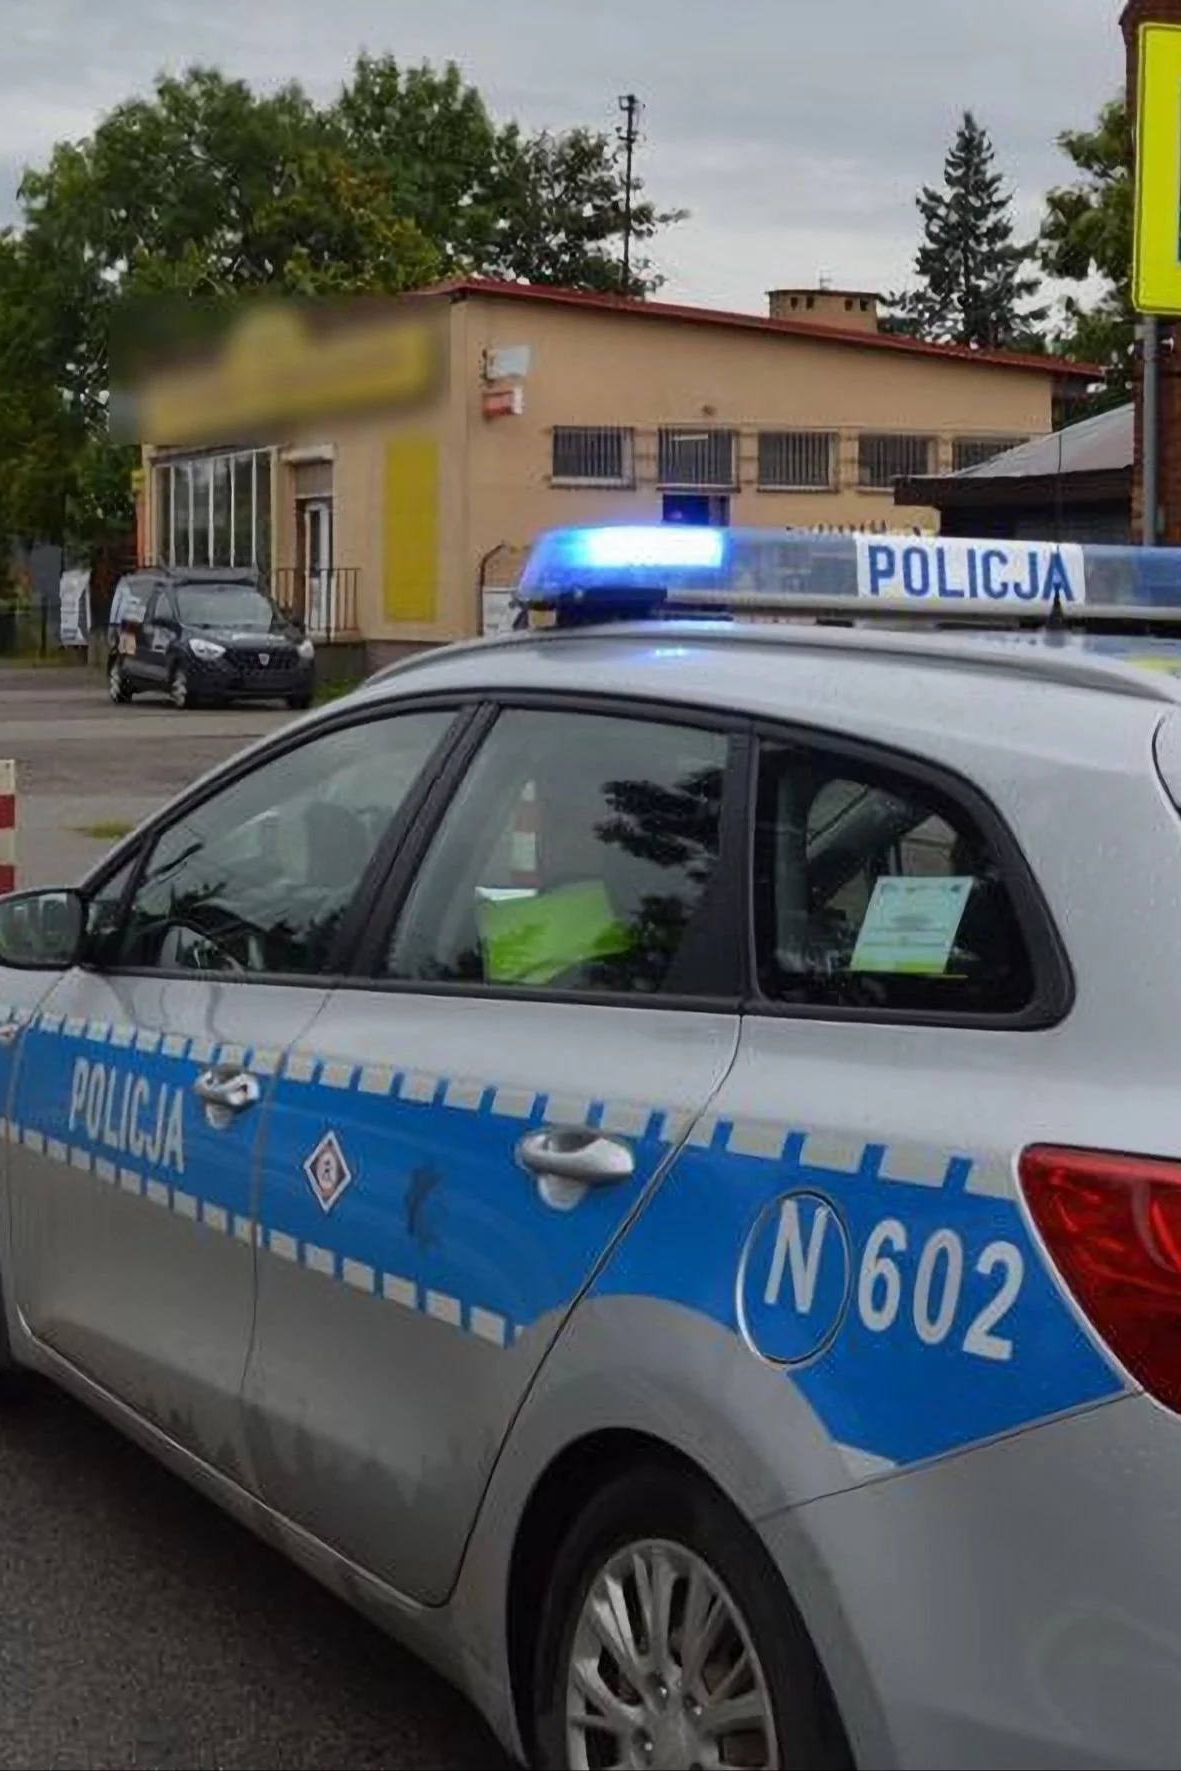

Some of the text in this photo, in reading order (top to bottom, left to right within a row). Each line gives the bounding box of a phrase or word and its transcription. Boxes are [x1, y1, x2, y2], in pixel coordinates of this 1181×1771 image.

[867, 544, 1075, 601] POLICJA
[68, 1056, 184, 1174] POLICJA
[764, 1199, 1023, 1360] N 602
